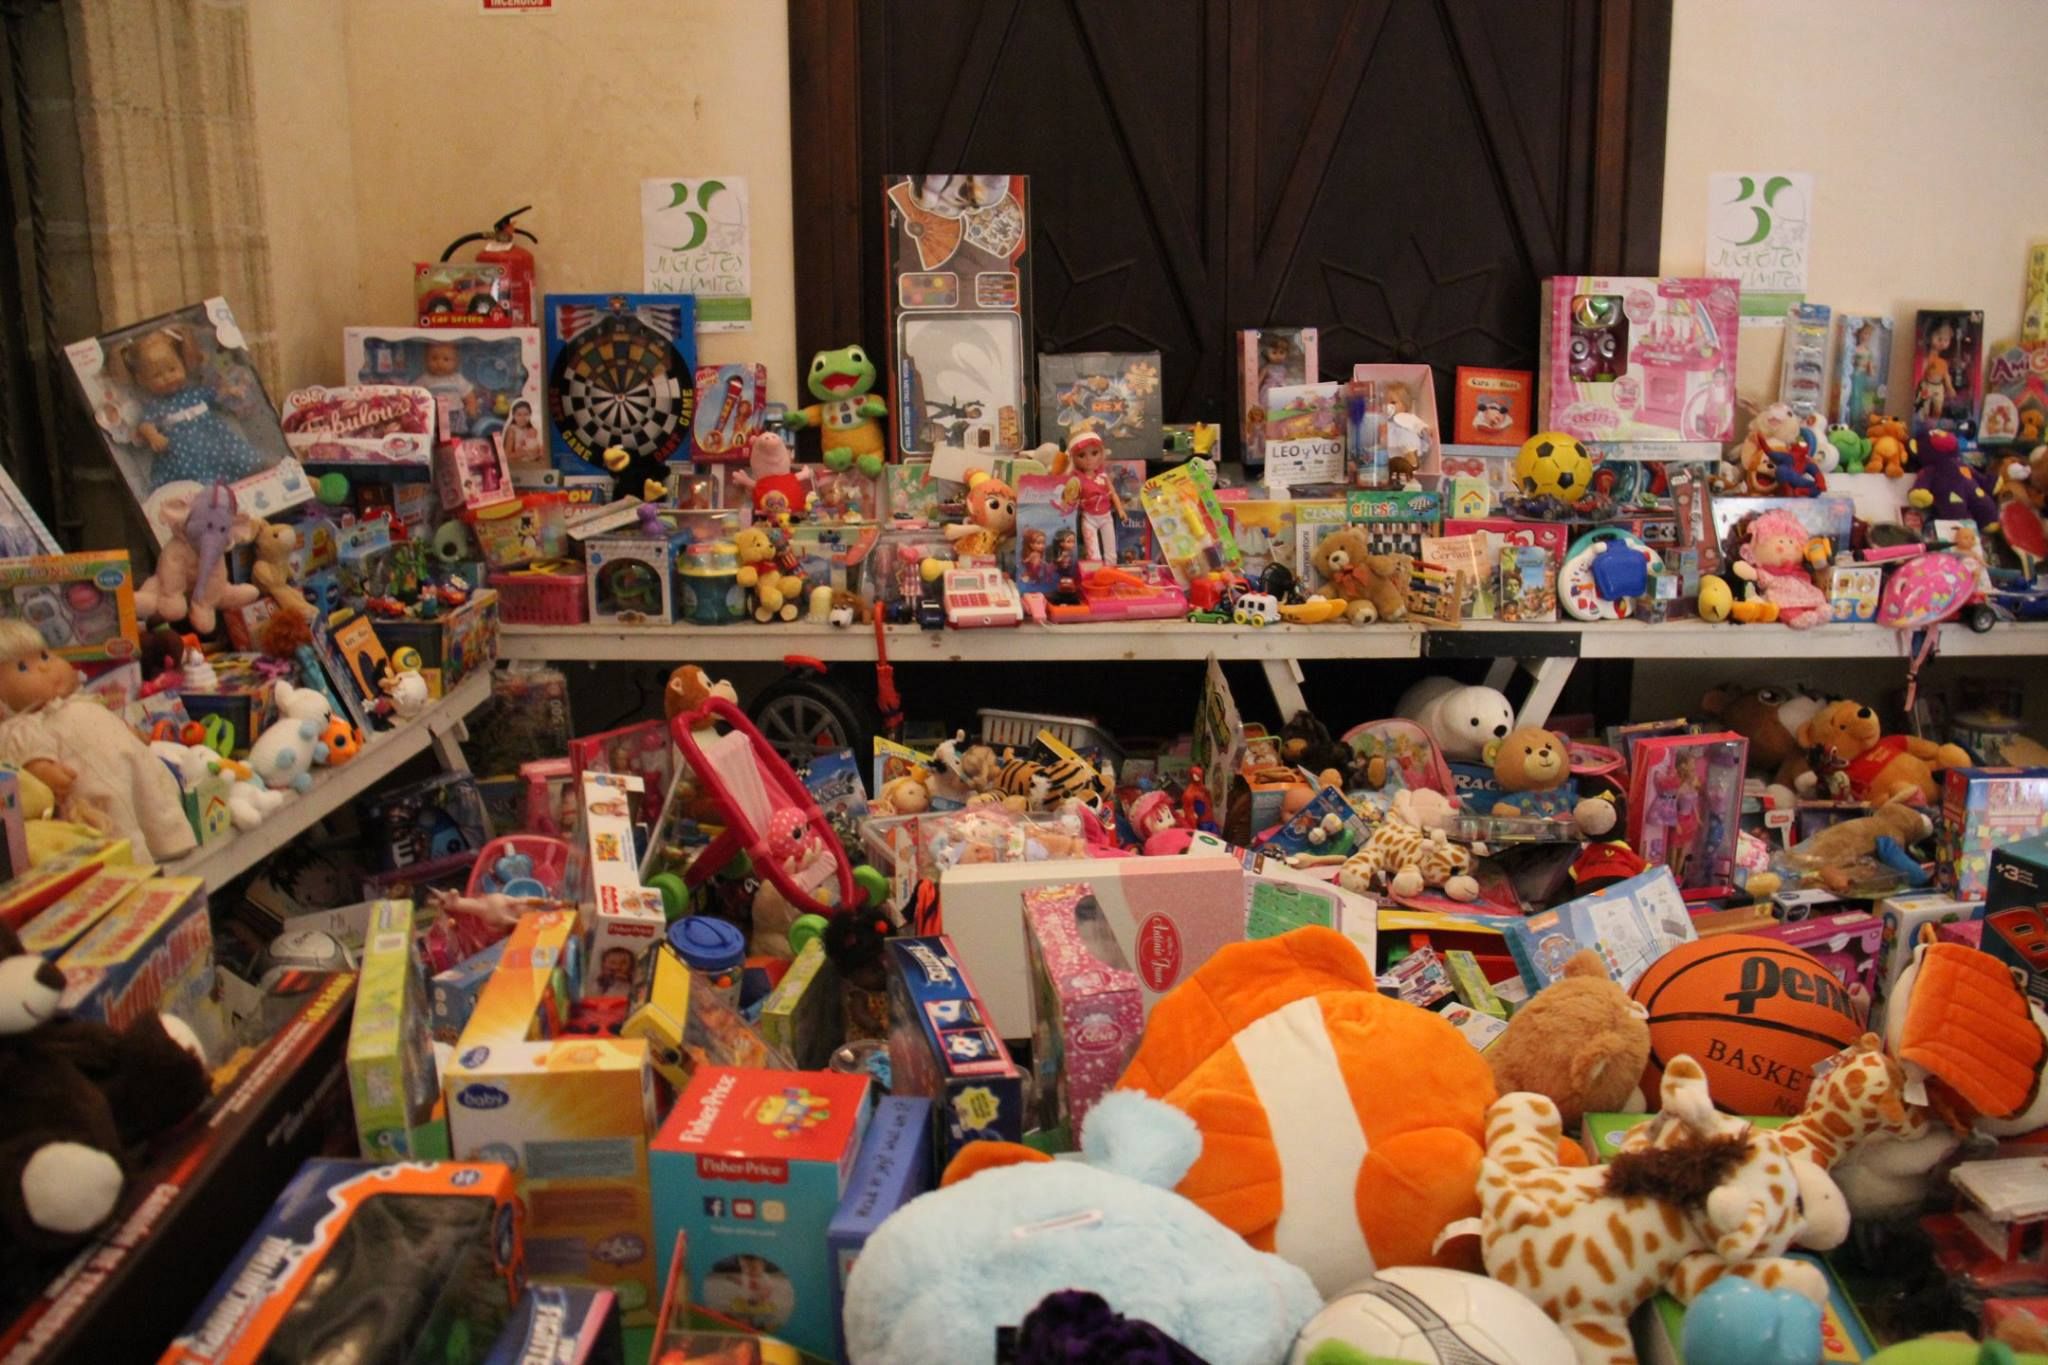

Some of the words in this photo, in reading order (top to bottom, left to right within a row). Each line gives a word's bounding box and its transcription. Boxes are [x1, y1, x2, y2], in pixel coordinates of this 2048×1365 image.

[1272, 446, 1300, 457] LEO
[1312, 443, 1341, 454] VEO
[703, 1157, 784, 1178] Fisher-Price
